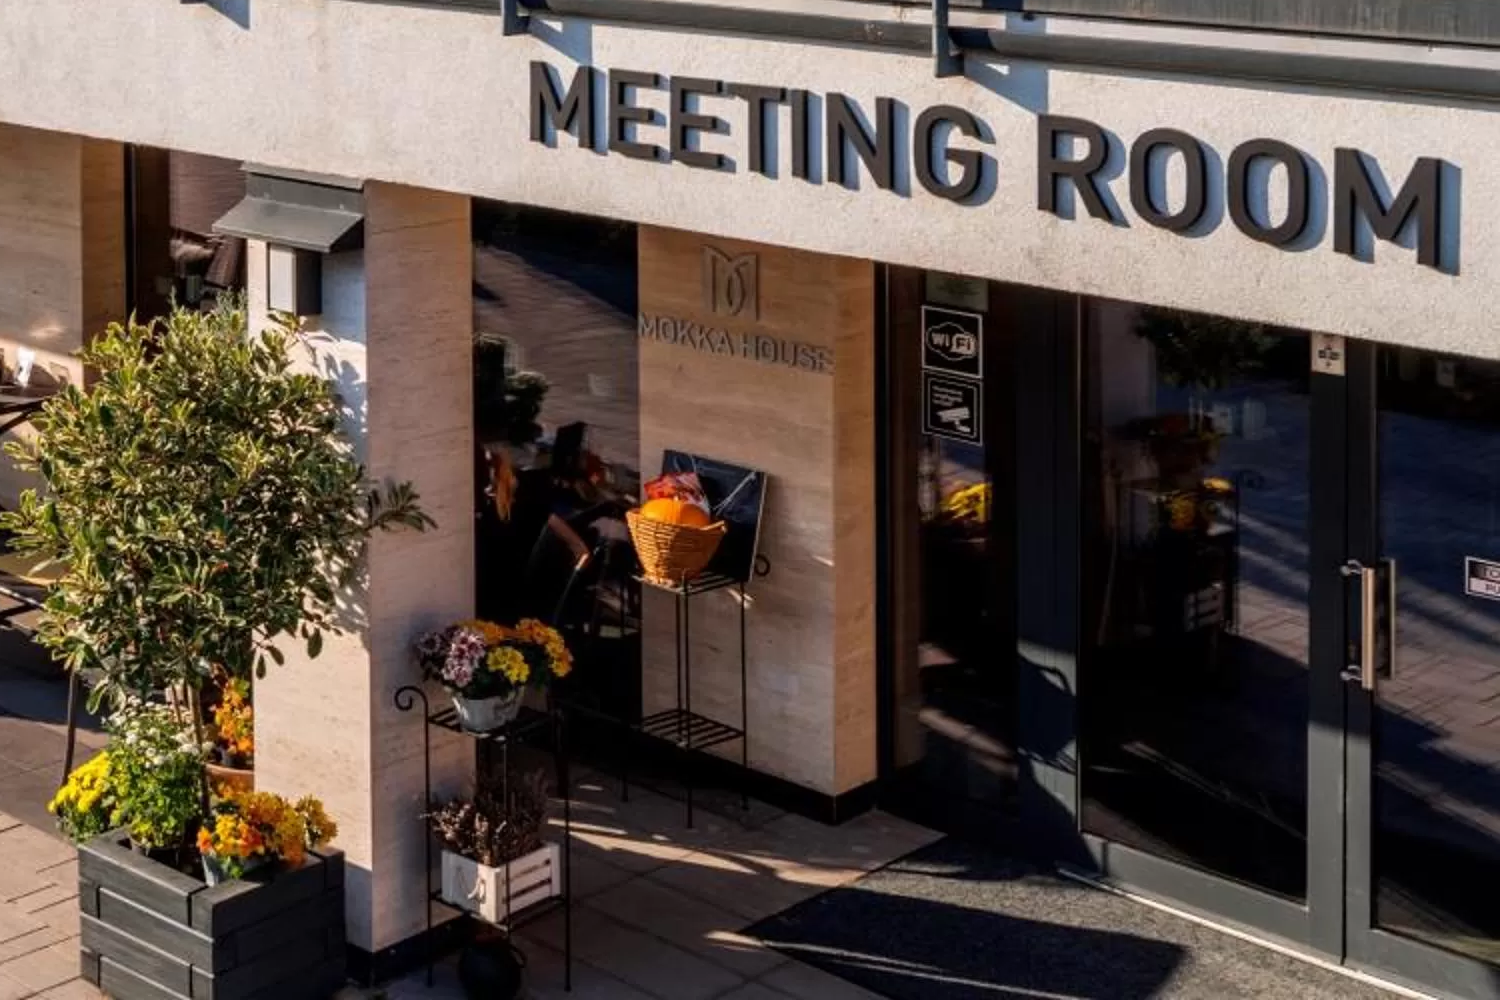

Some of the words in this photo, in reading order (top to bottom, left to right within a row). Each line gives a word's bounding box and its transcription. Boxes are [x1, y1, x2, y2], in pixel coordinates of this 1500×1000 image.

[529, 60, 996, 206] MEETING
[1037, 113, 1455, 272] ROOM
[638, 312, 734, 356] MOKKA
[740, 331, 835, 376] HOUSE
